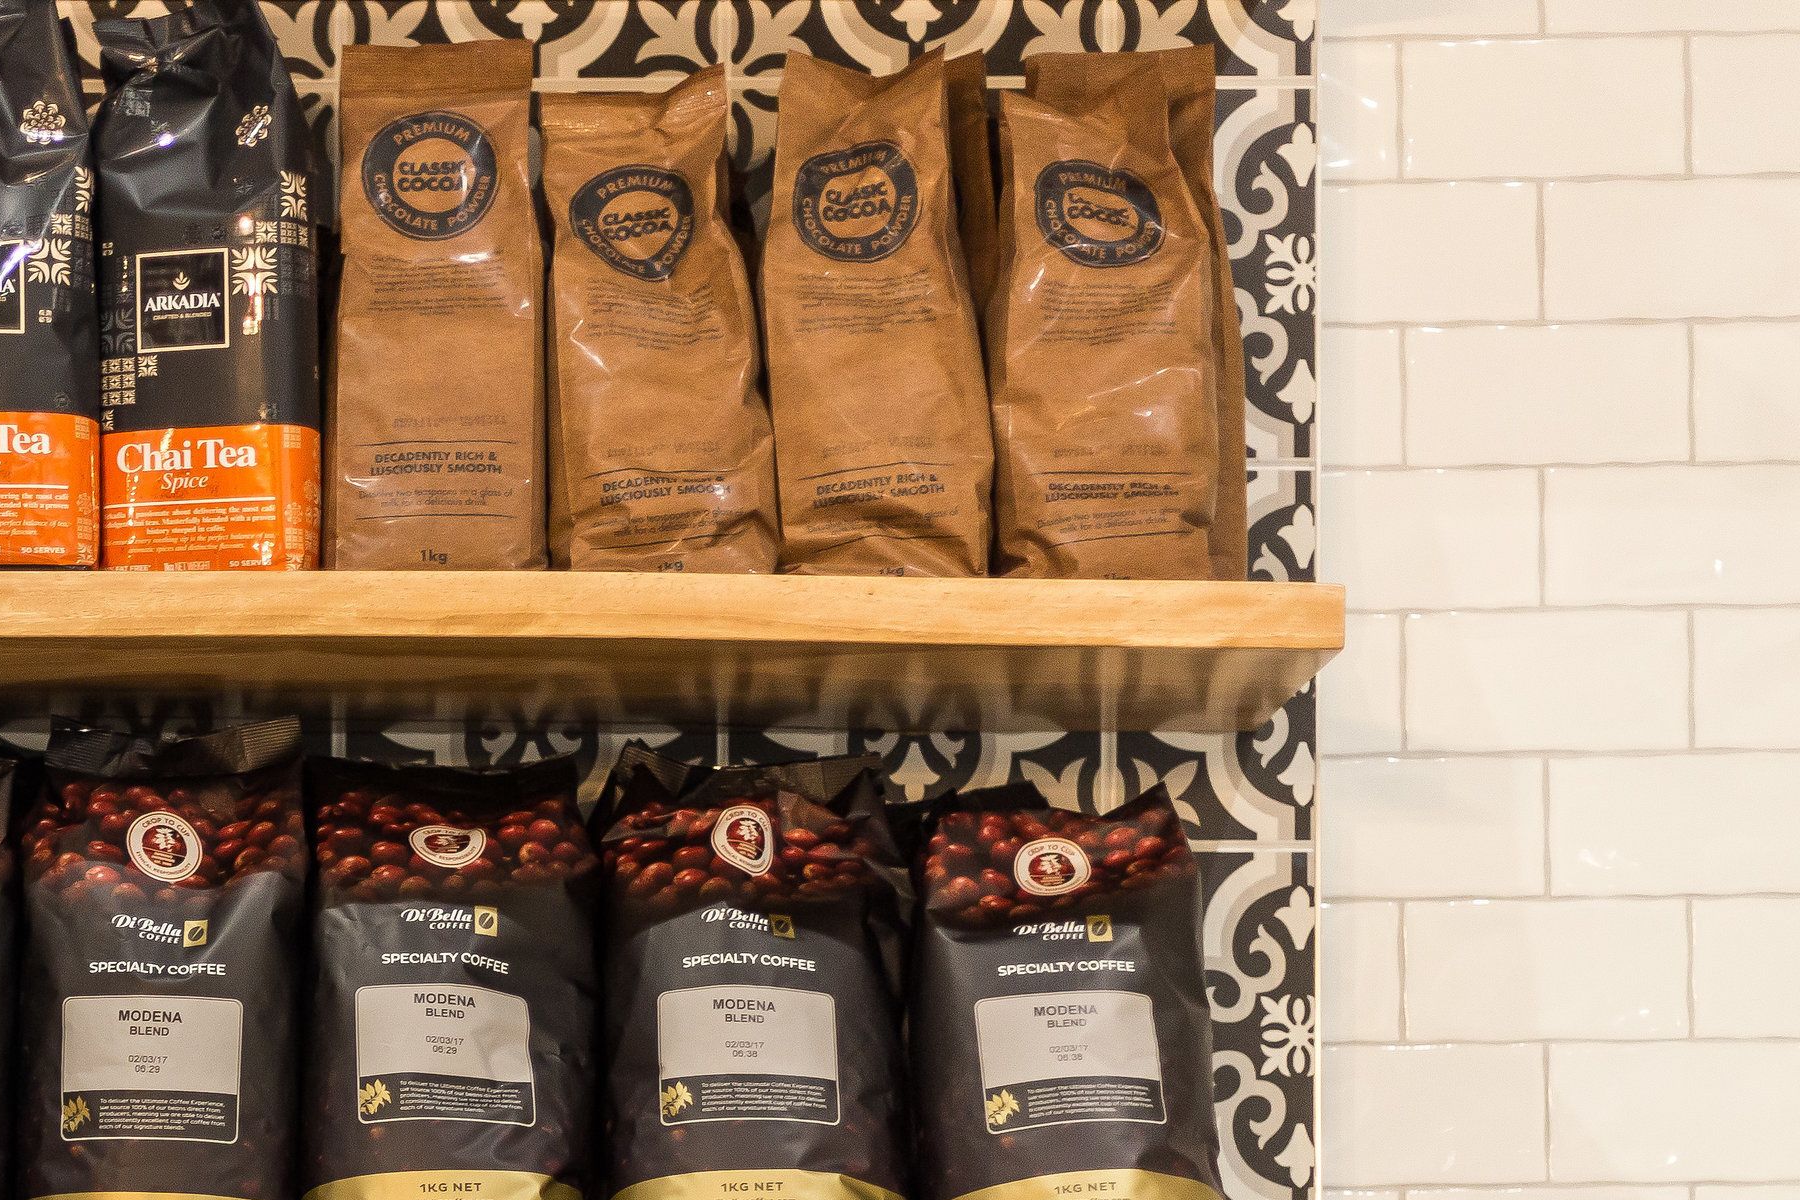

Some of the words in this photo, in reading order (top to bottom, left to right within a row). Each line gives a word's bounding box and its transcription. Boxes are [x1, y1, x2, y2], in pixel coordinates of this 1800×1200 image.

[393, 122, 469, 144] PREMIUM
[597, 176, 673, 199] PREMIUM
[375, 174, 438, 230] CHOCOLATE
[447, 175, 491, 226] POWDER
[145, 292, 219, 312] ARKADIA
[116, 440, 192, 472] Chai
[196, 439, 258, 468] Tea
[375, 452, 451, 464] DECADENTLY
[455, 451, 484, 461] RICH
[488, 452, 496, 461] &
[370, 463, 442, 476] LUSCIOUSLY
[447, 462, 503, 474] SMOOTH
[160, 472, 209, 489] Spice
[816, 475, 892, 496] DECADENTLY
[896, 473, 924, 485] RICH
[419, 549, 448, 566] 1kg
[142, 818, 162, 828] CROP
[177, 825, 190, 837] CUP
[429, 922, 471, 931] COFFEE
[138, 932, 180, 944] COFFEE
[1043, 933, 1085, 941] COFFEE
[89, 961, 165, 974] SPECIALTY
[167, 964, 226, 975] COFFEE
[382, 953, 459, 965] SPECIALTY
[461, 953, 509, 975] COFFEE
[683, 952, 759, 968] SPECIALTY
[761, 955, 816, 972] COFFEE
[998, 962, 1074, 977] SPECIALTY
[1077, 961, 1135, 973] COFFEE
[414, 993, 476, 1008] MODENA
[713, 999, 776, 1012] MODENA
[118, 1010, 182, 1023] MODENA
[425, 1008, 465, 1019] BLEND
[1033, 1005, 1098, 1017] MODENA
[725, 1014, 765, 1024] BLEND
[1047, 1019, 1087, 1029] BLEND
[129, 1026, 170, 1036] BLEND
[425, 1035, 464, 1046] 02/03/17
[128, 1055, 167, 1064] 02/03/17
[419, 1183, 448, 1193] 1KG
[453, 1182, 482, 1192] NET
[720, 1182, 749, 1192] 1KG
[754, 1182, 784, 1191] NET
[1054, 1184, 1082, 1195] 1KG
[1088, 1182, 1117, 1192] NET
